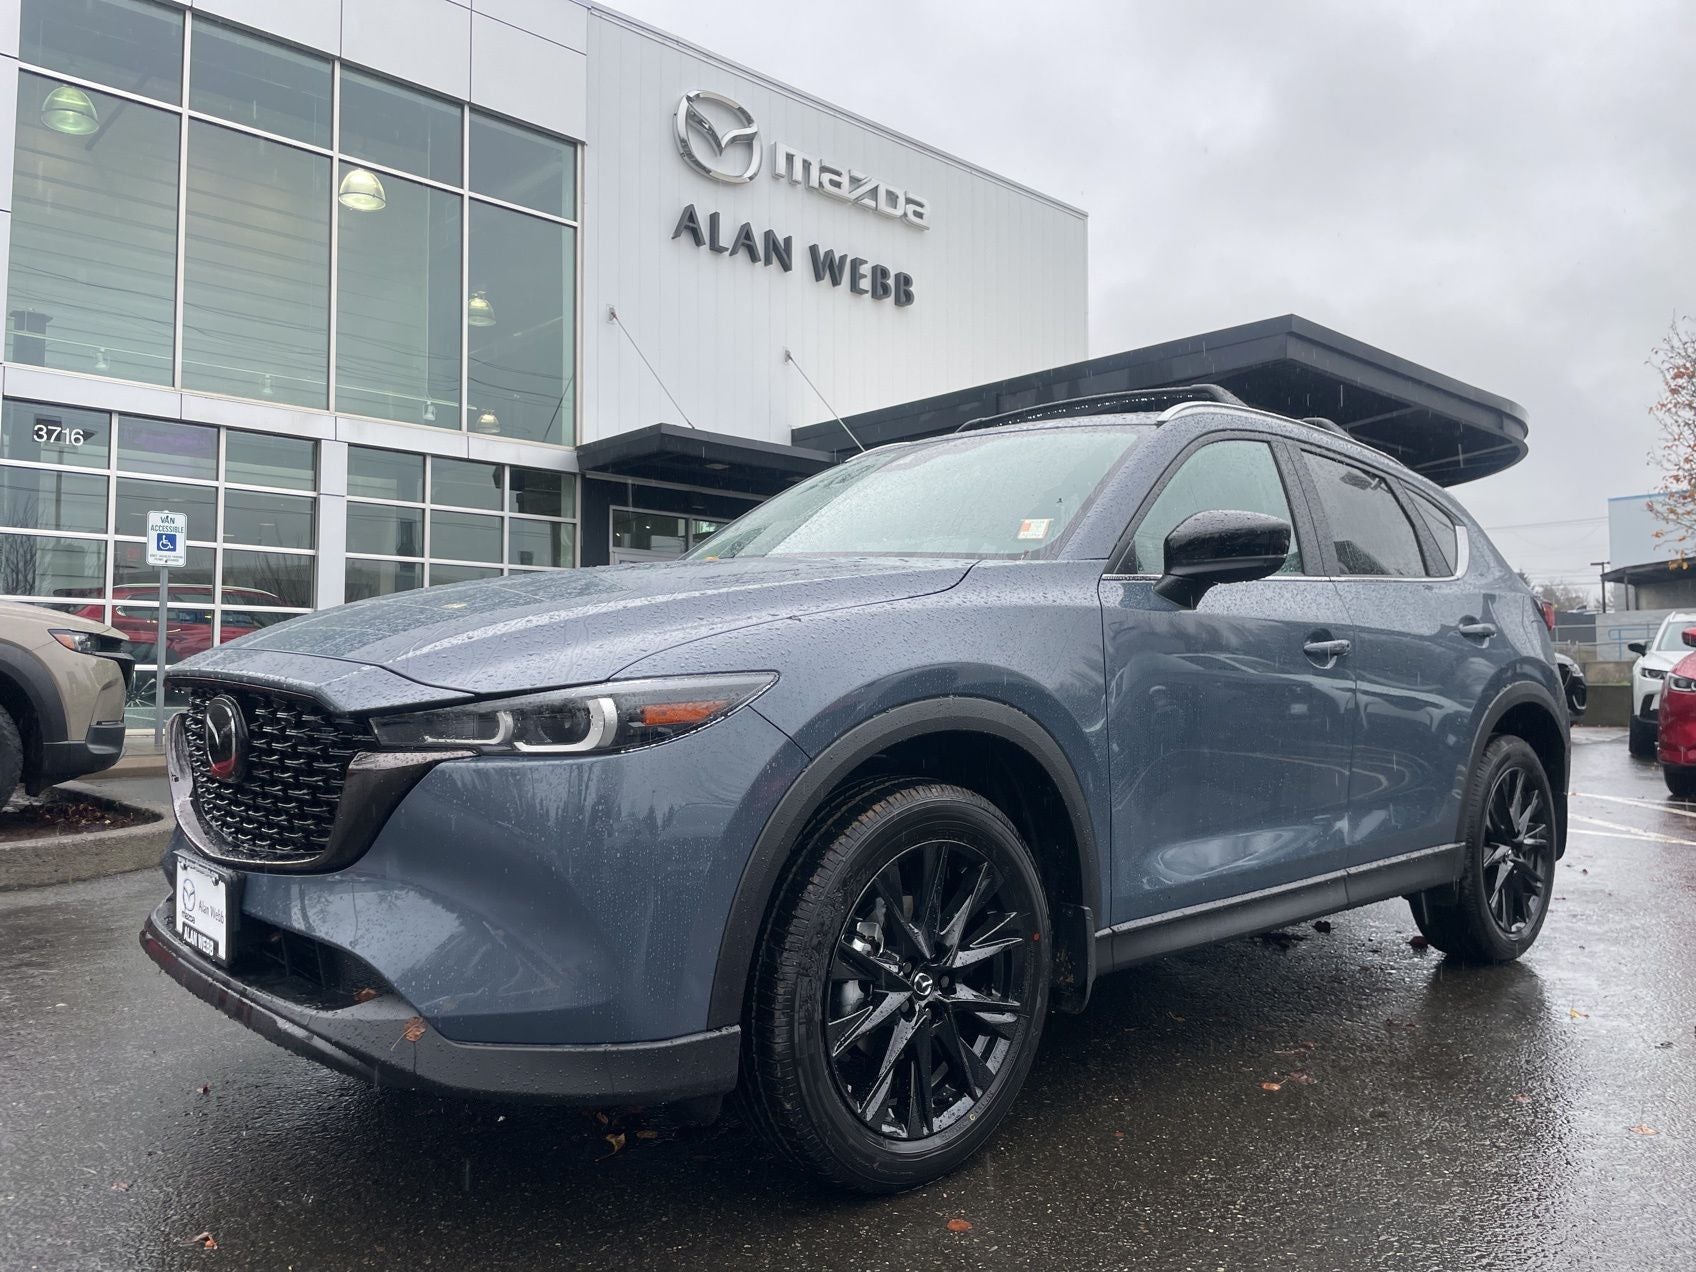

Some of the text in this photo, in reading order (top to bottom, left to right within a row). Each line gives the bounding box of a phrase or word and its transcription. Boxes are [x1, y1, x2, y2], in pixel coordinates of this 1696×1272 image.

[771, 141, 930, 230] mazda
[671, 203, 915, 307] ALAN WEBB
[33, 424, 84, 446] 3716
[150, 524, 184, 533] ACCESSIBLE
[160, 516, 175, 524] VAN
